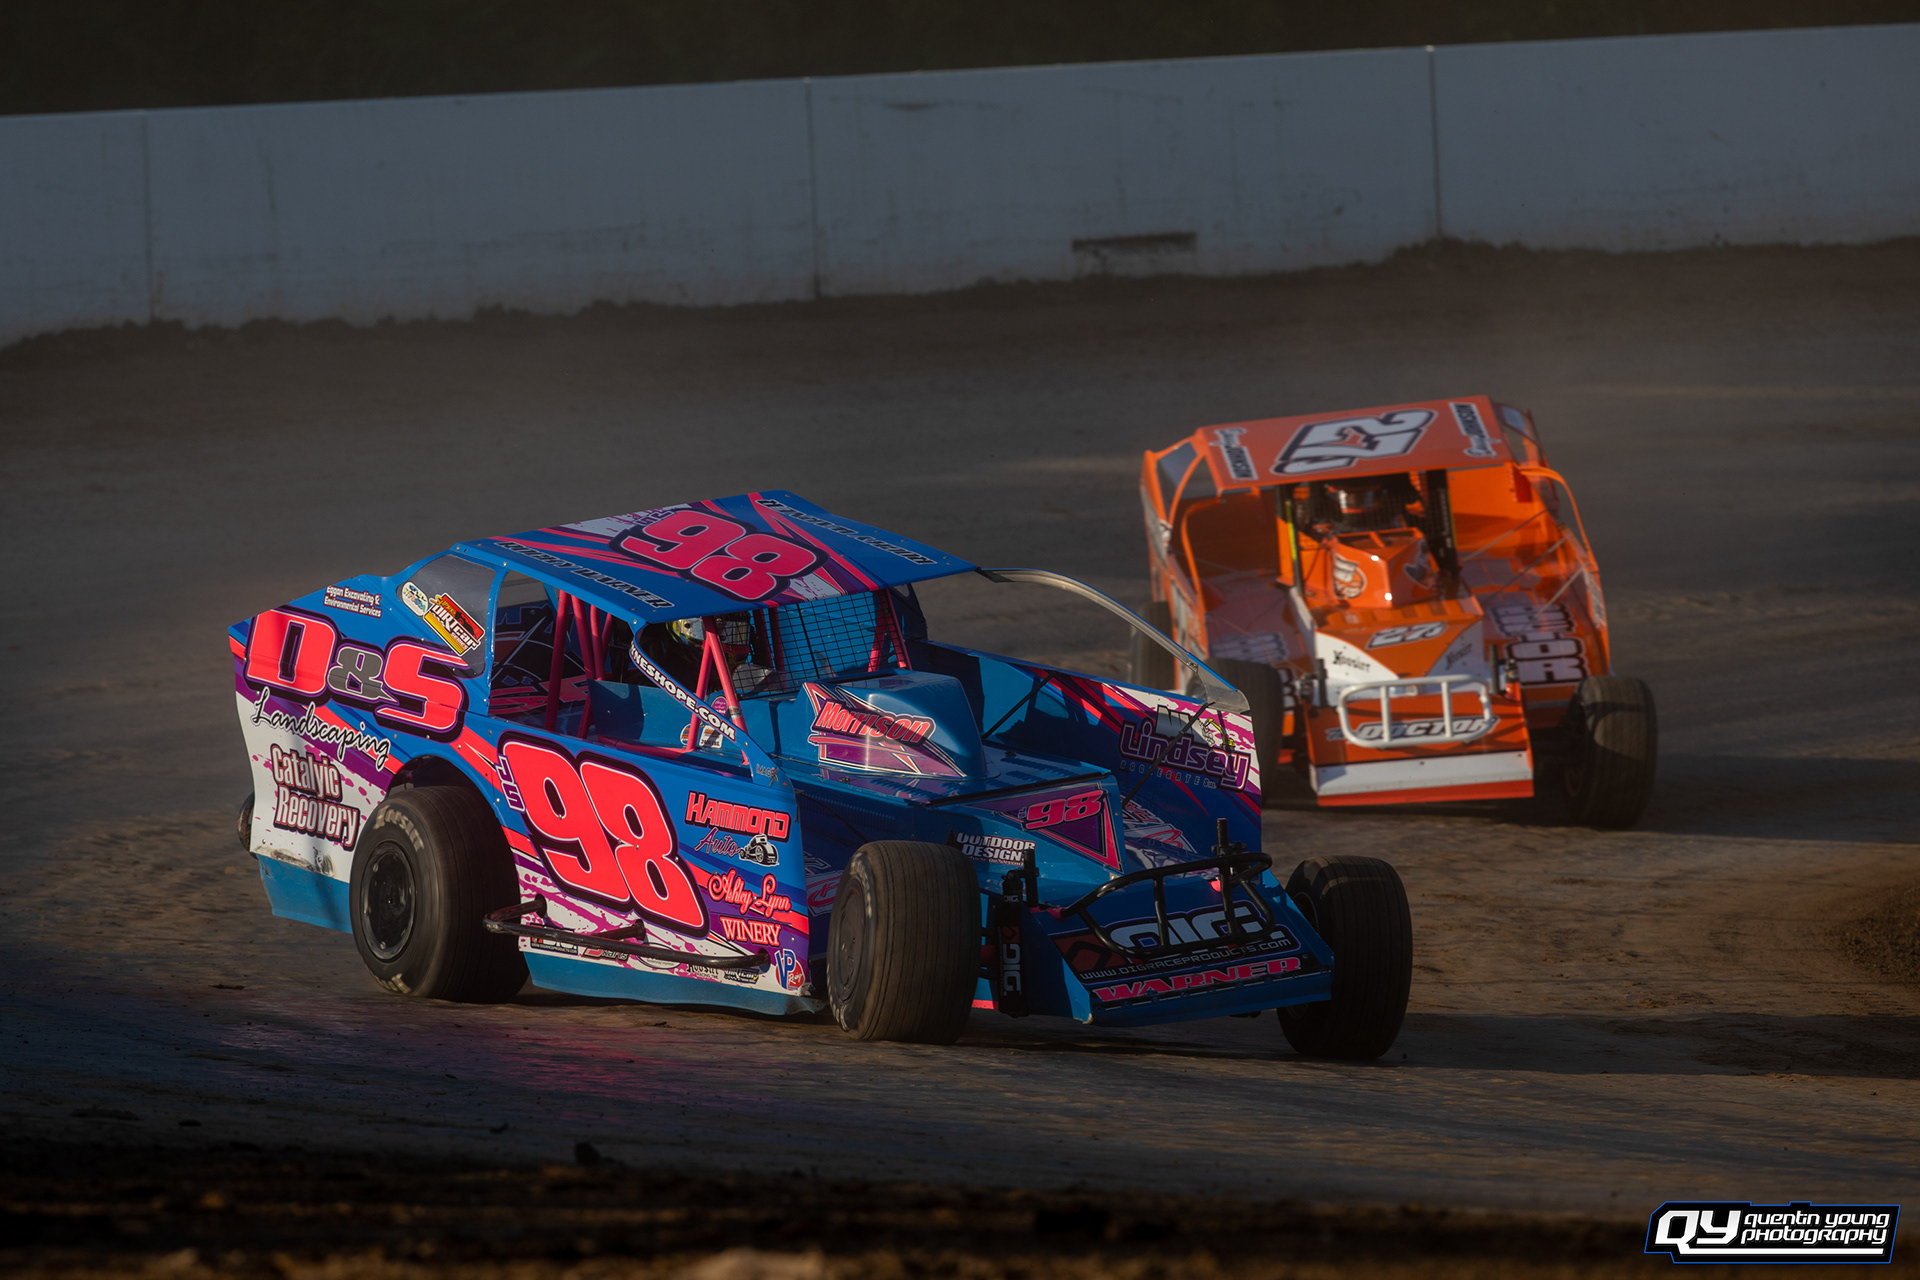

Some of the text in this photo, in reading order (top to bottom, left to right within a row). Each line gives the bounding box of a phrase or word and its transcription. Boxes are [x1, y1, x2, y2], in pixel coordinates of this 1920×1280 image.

[620, 509, 817, 600] 98
[360, 604, 382, 617] Services
[246, 608, 470, 733] D&S
[252, 687, 390, 769] Landscaping
[272, 746, 341, 799] Catalyic
[1121, 720, 1249, 791] Lindsey
[275, 787, 358, 848] Recovery
[1025, 790, 1103, 829] 98
[502, 741, 705, 928] 98
[695, 827, 740, 856] Auto
[956, 832, 1036, 850] OUTDOOR
[755, 874, 791, 917] Lynn
[720, 916, 782, 946] WINERY
[775, 949, 796, 990] VP
[1094, 957, 1300, 1001] WARNER
